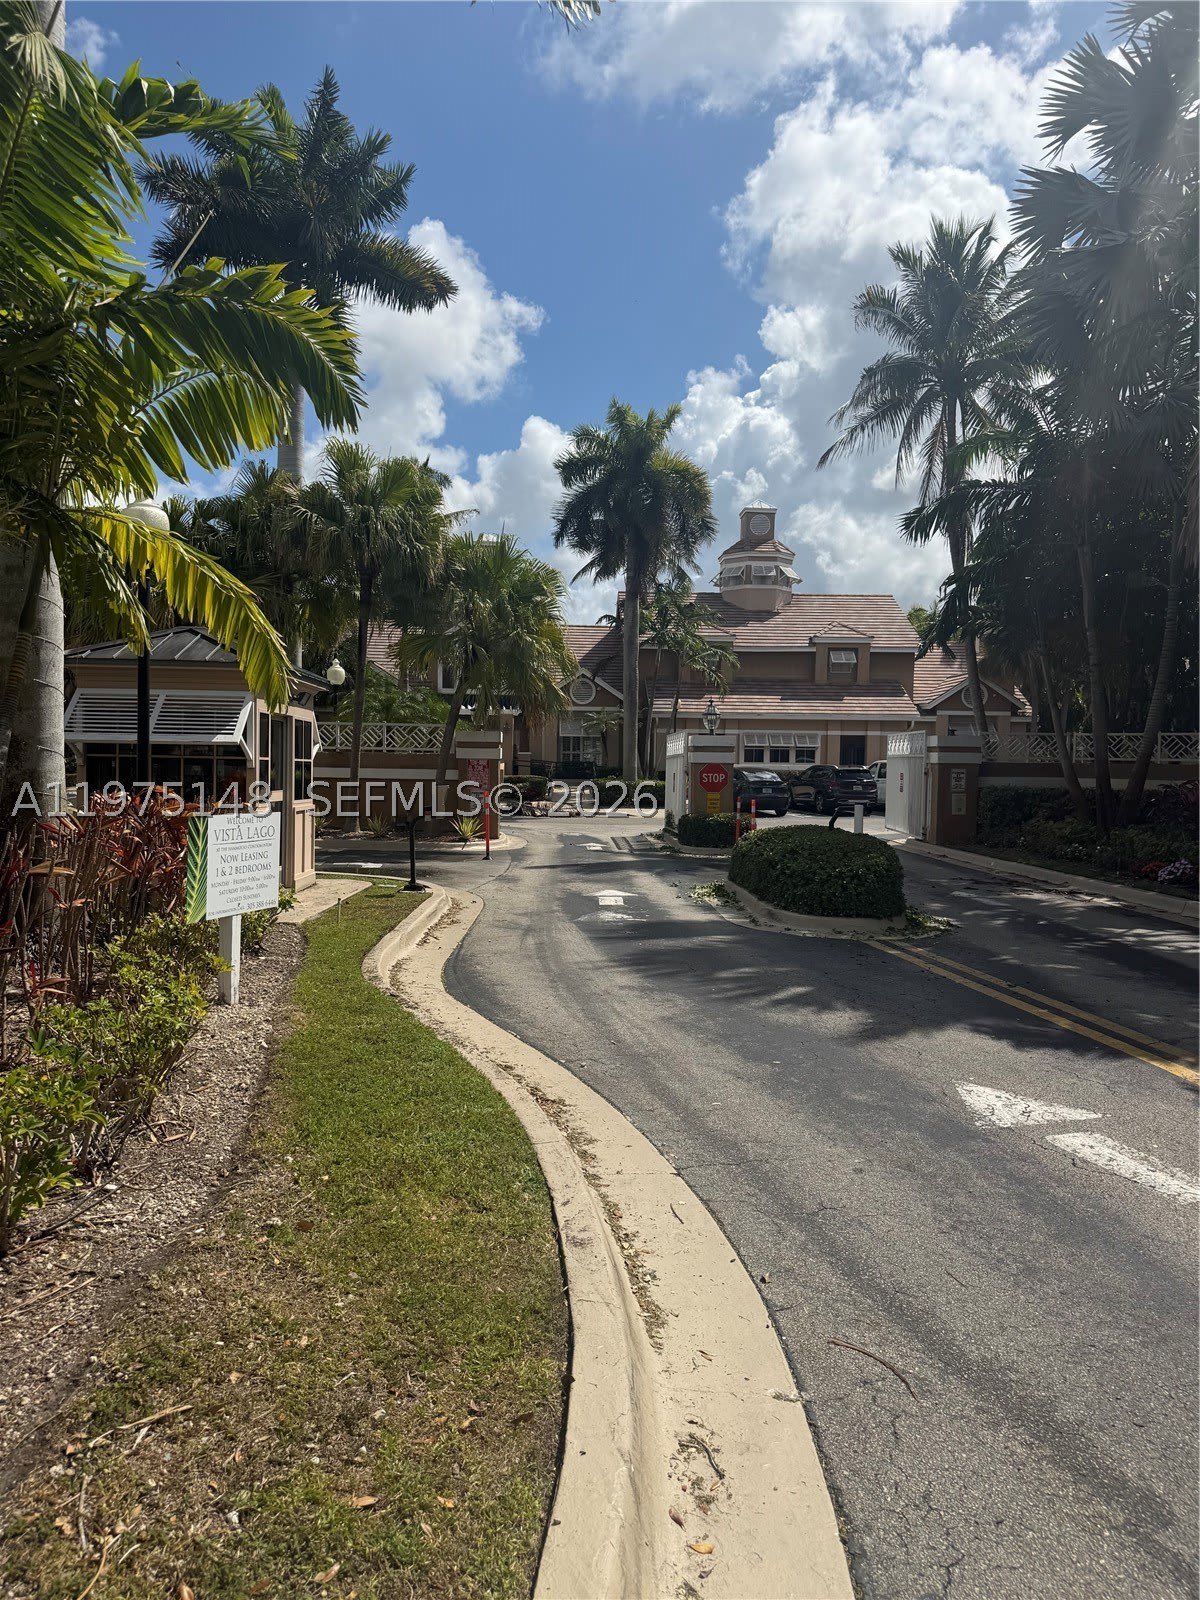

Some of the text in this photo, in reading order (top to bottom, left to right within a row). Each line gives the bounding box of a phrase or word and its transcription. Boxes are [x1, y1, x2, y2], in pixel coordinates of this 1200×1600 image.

[702, 773, 726, 783] STOP
[226, 817, 254, 825] WELCOME
[247, 825, 275, 840] LAGO
[220, 850, 268, 865] NOW LEASING
[220, 866, 227, 877] &
[228, 865, 233, 876] 2
[234, 862, 272, 875] BEDROOMS
